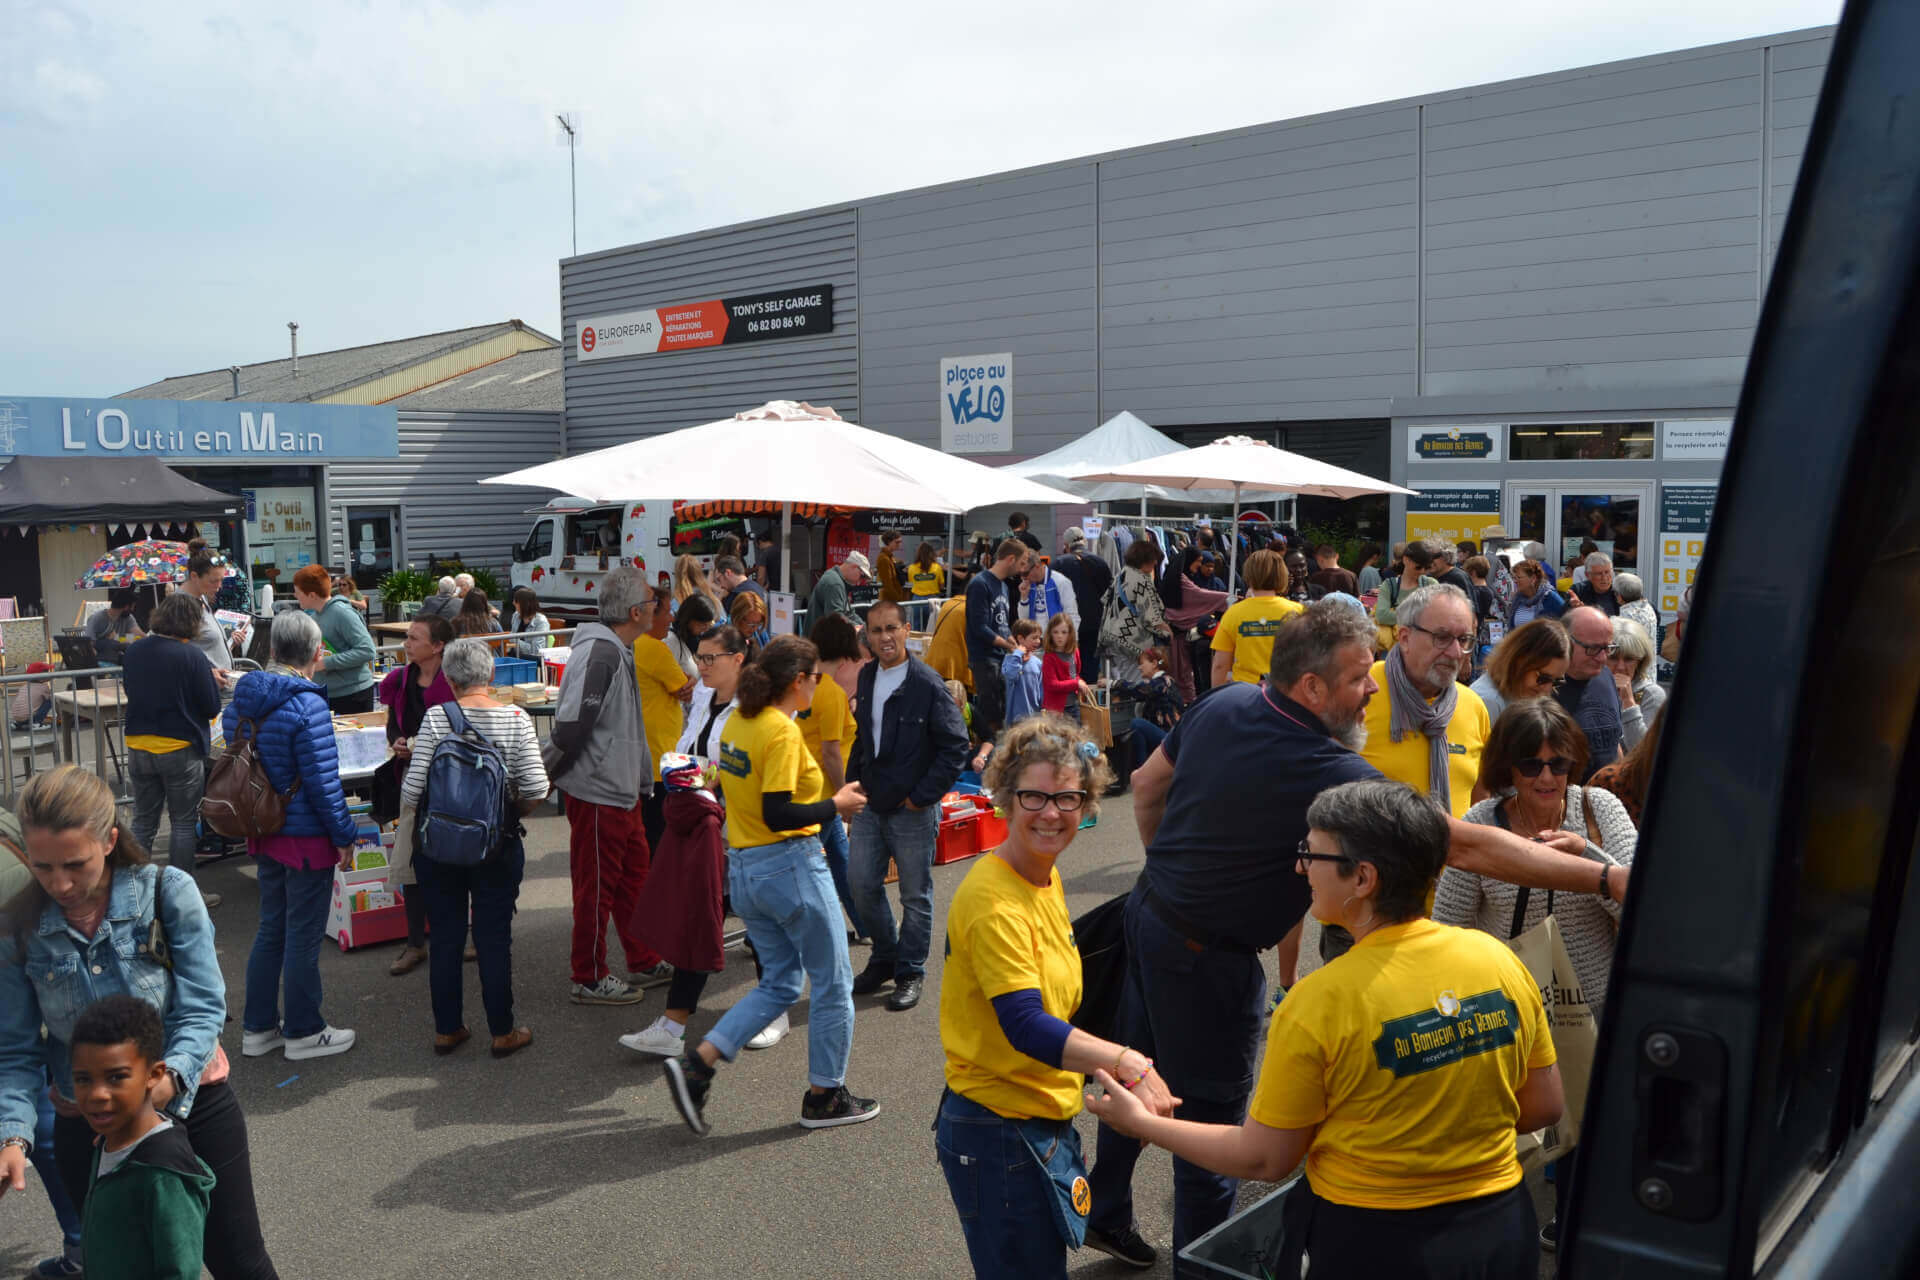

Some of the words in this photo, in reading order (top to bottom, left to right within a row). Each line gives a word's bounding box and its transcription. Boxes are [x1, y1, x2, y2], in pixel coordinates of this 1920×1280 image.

[732, 302, 764, 317] TONY'S
[765, 300, 785, 313] SELF
[785, 294, 823, 310] GARAGE
[598, 322, 653, 340] EUROREPAR
[748, 321, 759, 333] 06
[760, 319, 770, 331] 82
[770, 318, 781, 330] 80
[782, 316, 793, 328] 86
[794, 314, 806, 327] 90
[946, 364, 985, 386] place
[987, 364, 1006, 379] au
[194, 430, 232, 451] en
[239, 411, 324, 452] Main
